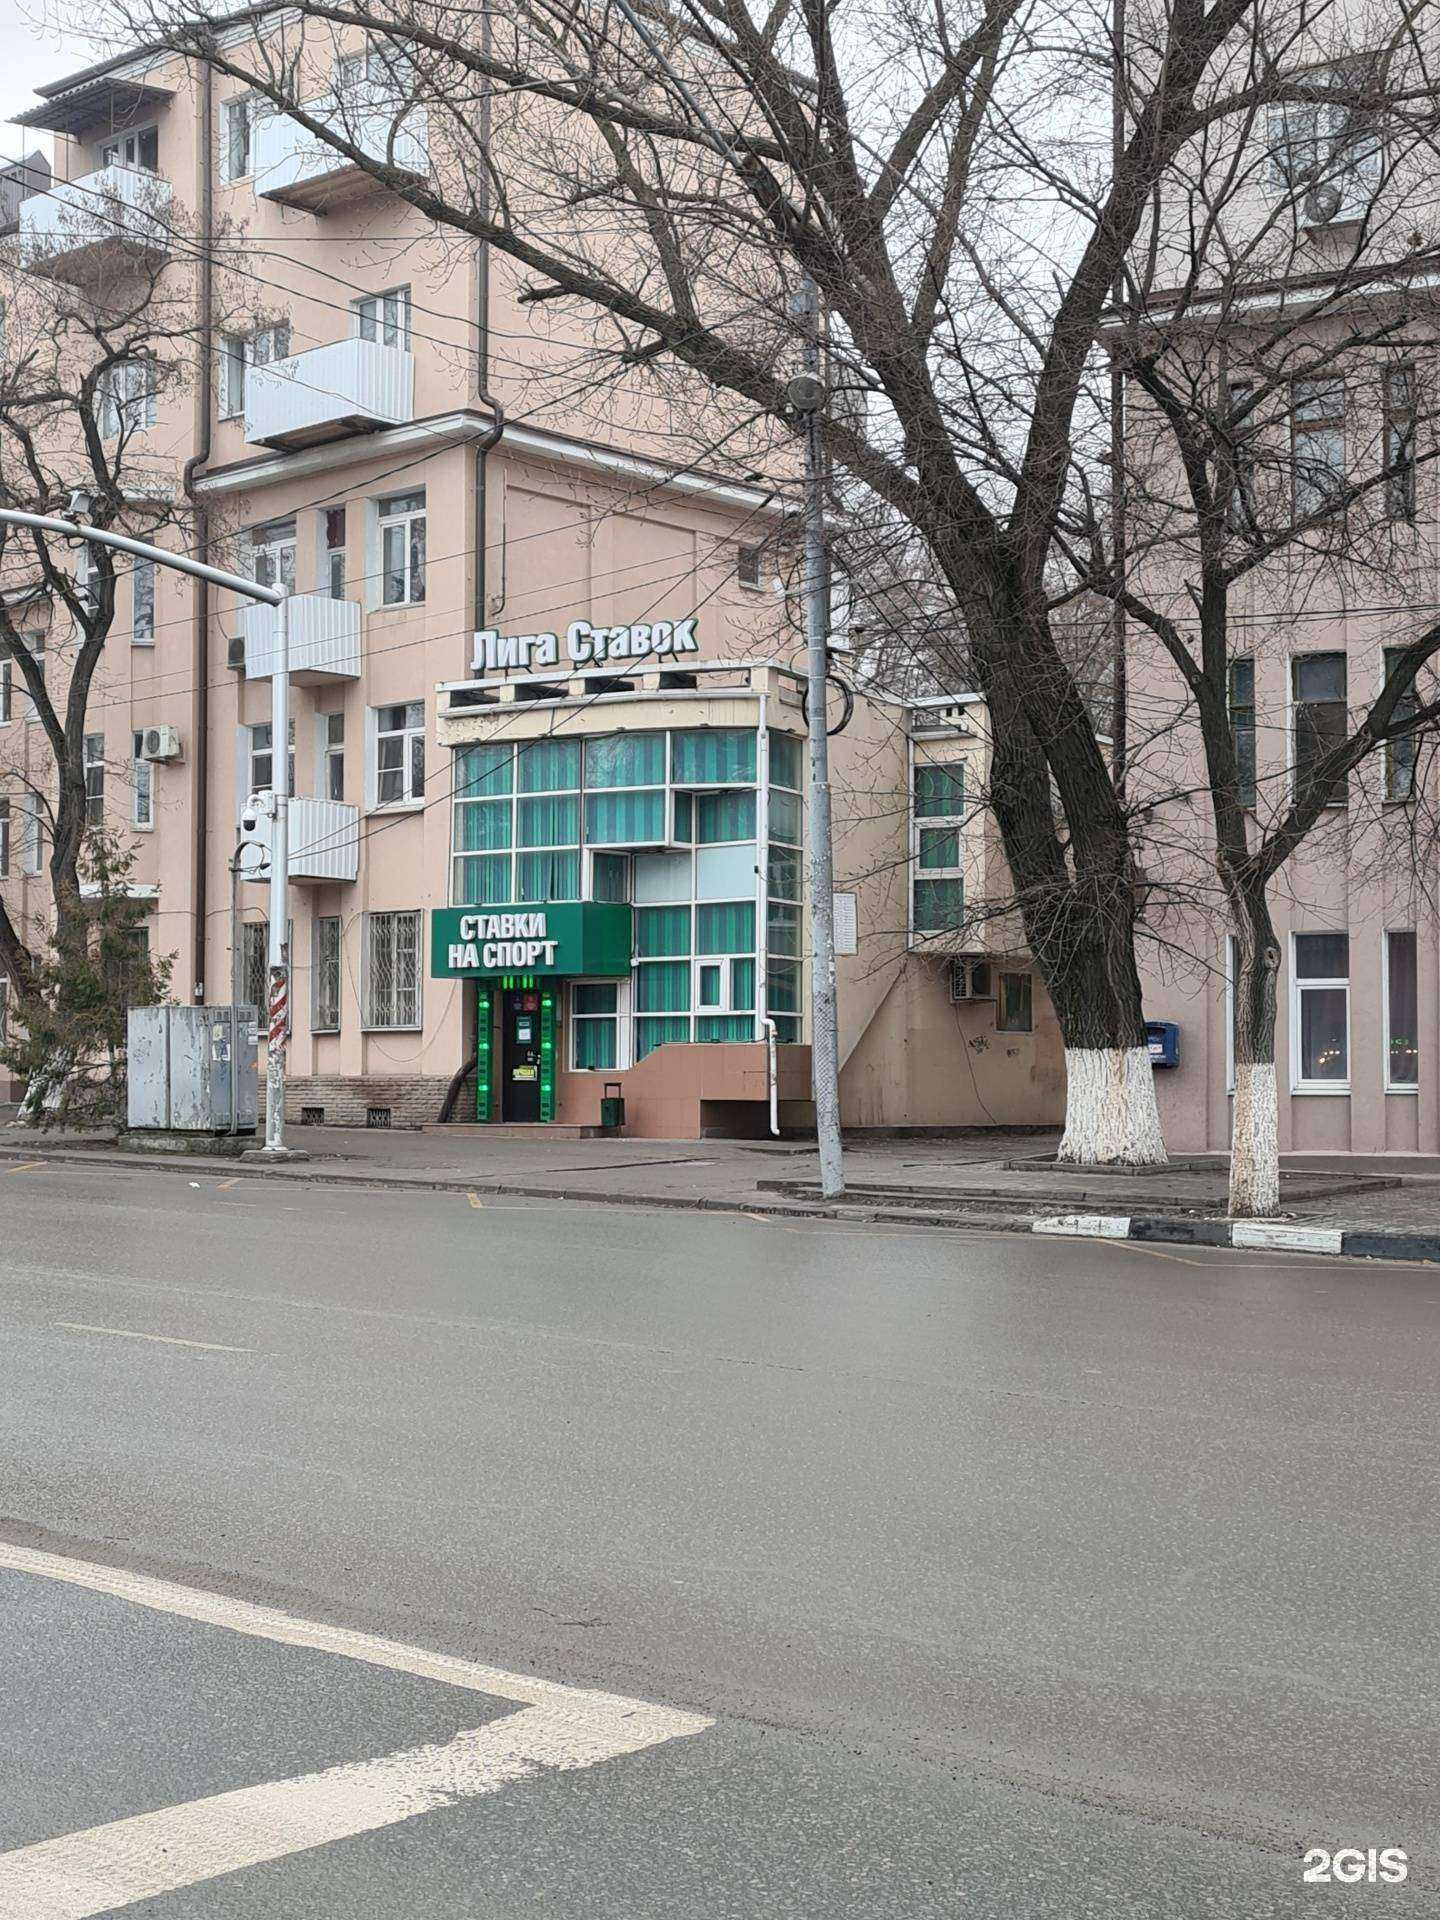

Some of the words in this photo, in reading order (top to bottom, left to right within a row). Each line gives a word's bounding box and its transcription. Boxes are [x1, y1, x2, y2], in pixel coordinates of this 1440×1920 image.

[470, 629, 559, 671] Лига
[566, 618, 699, 663] Ставок
[460, 912, 547, 941] СТАВКИ
[448, 943, 480, 969] НА
[482, 940, 558, 968] СПОРТ
